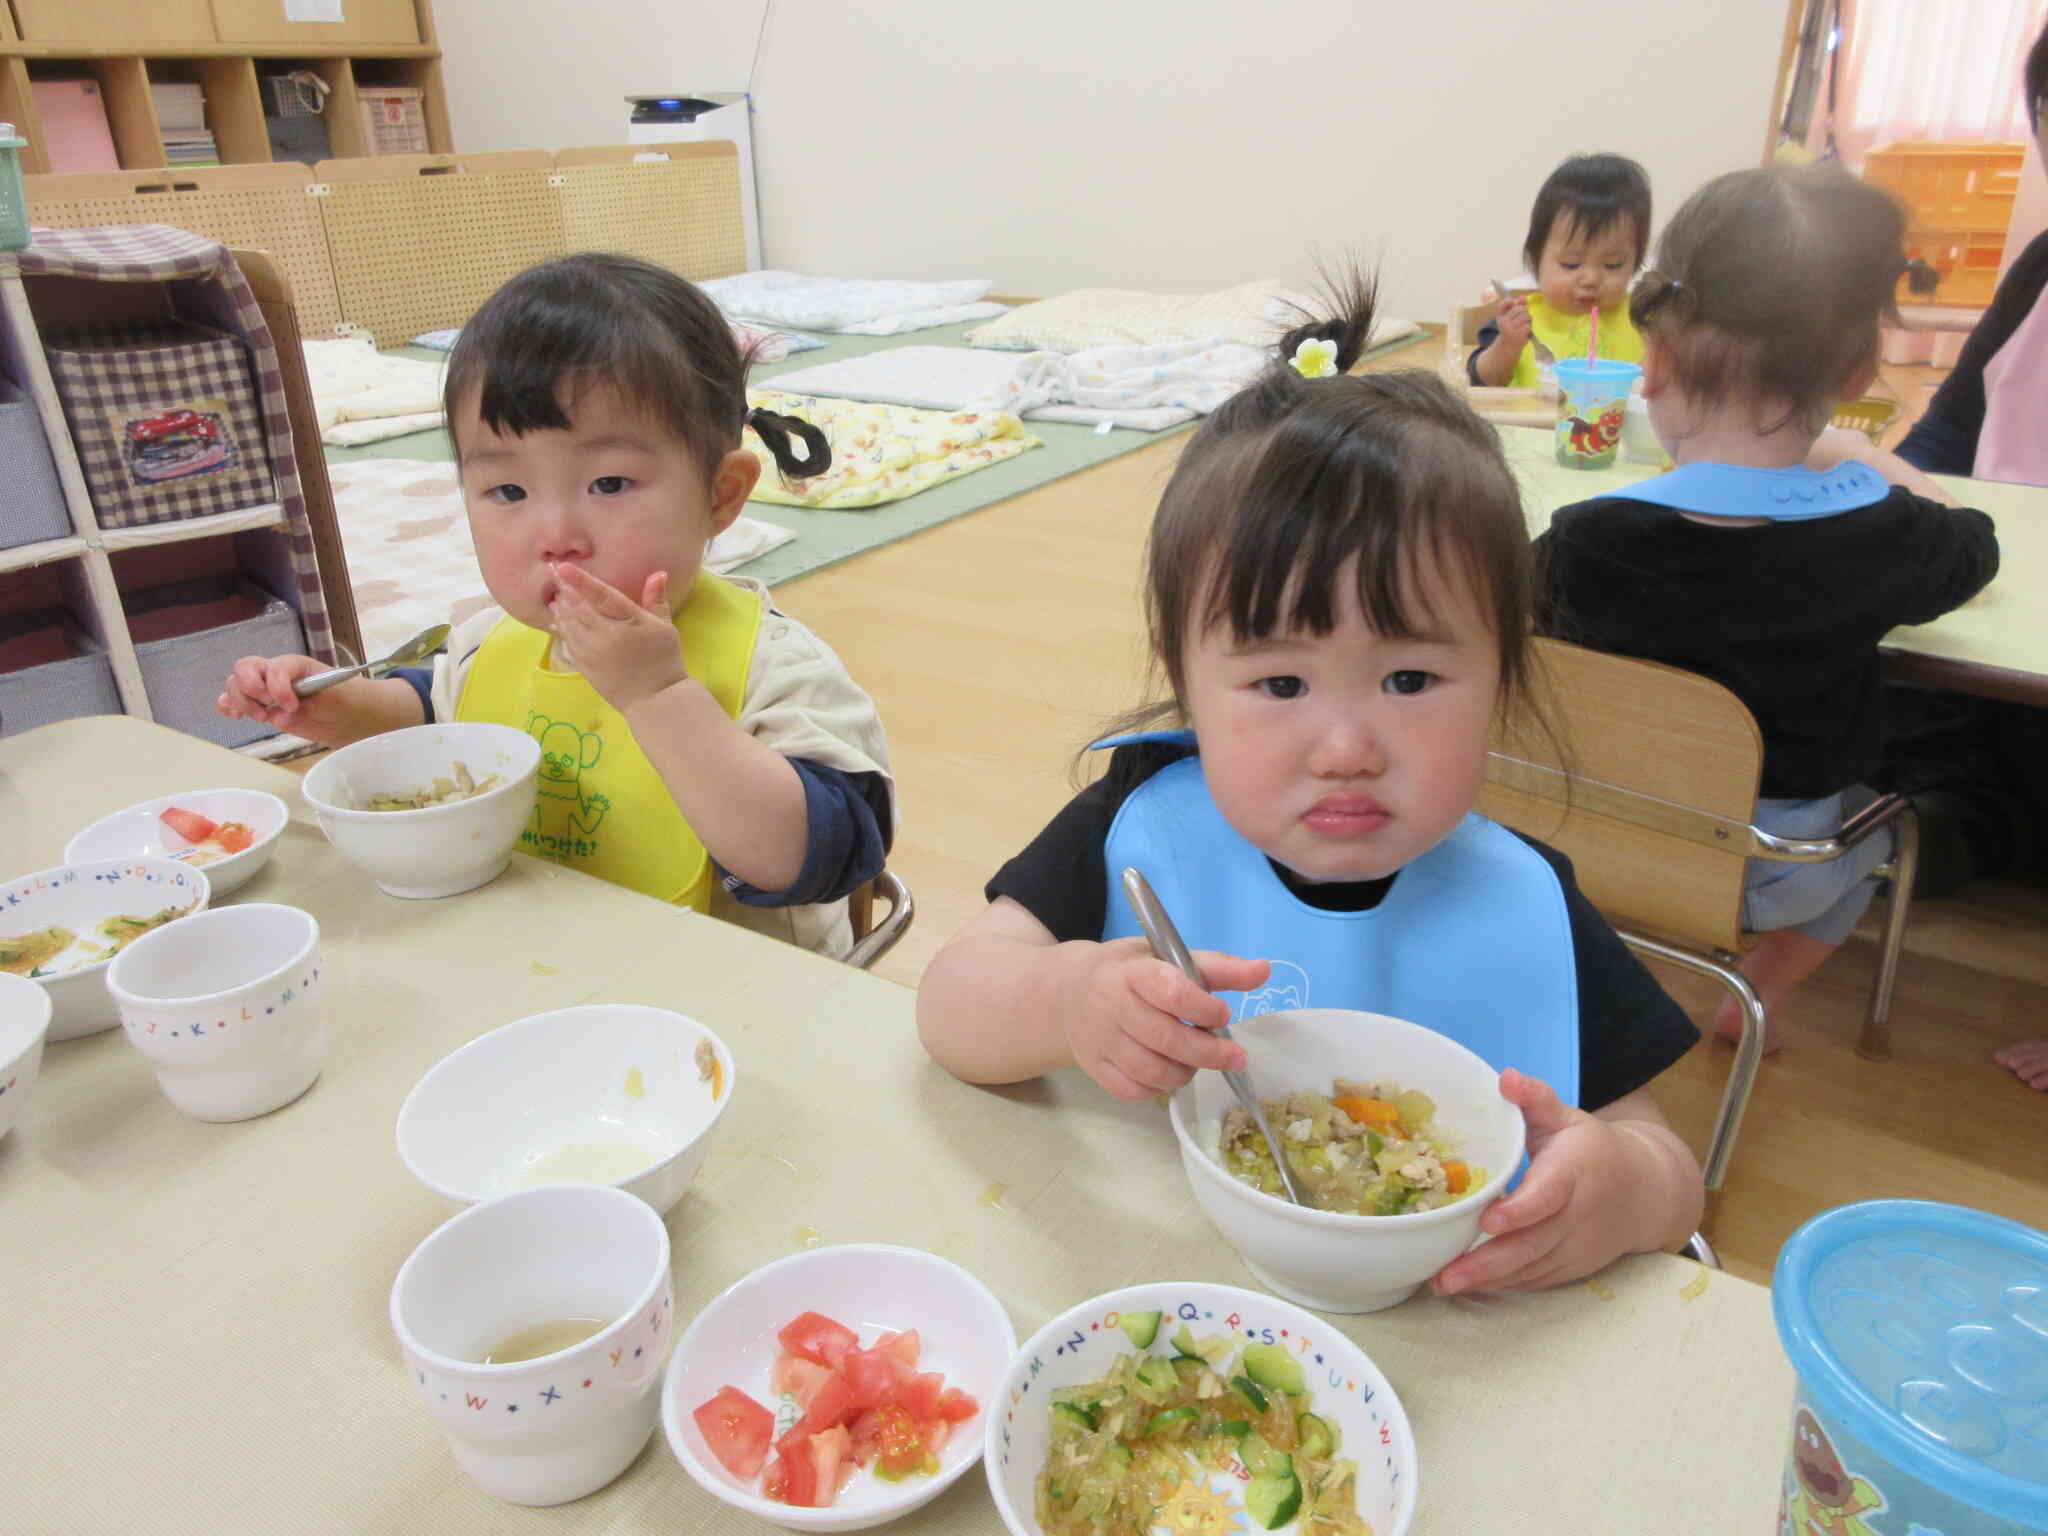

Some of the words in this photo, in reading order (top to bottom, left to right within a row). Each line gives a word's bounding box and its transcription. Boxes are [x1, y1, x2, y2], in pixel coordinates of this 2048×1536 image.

[135, 866, 147, 877] O
[176, 872, 186, 886] Q
[190, 1022, 206, 1037] K
[240, 1007, 254, 1020] L
[1066, 1330, 1086, 1353] N
[1178, 1302, 1200, 1321] Q
[1225, 1311, 1242, 1331] R
[1261, 1328, 1276, 1346] S
[1300, 1335, 1313, 1353] T
[1328, 1369, 1343, 1389] U
[1363, 1382, 1376, 1404] V
[465, 1391, 489, 1411] W
[539, 1385, 563, 1406] X
[609, 1348, 623, 1369] Y
